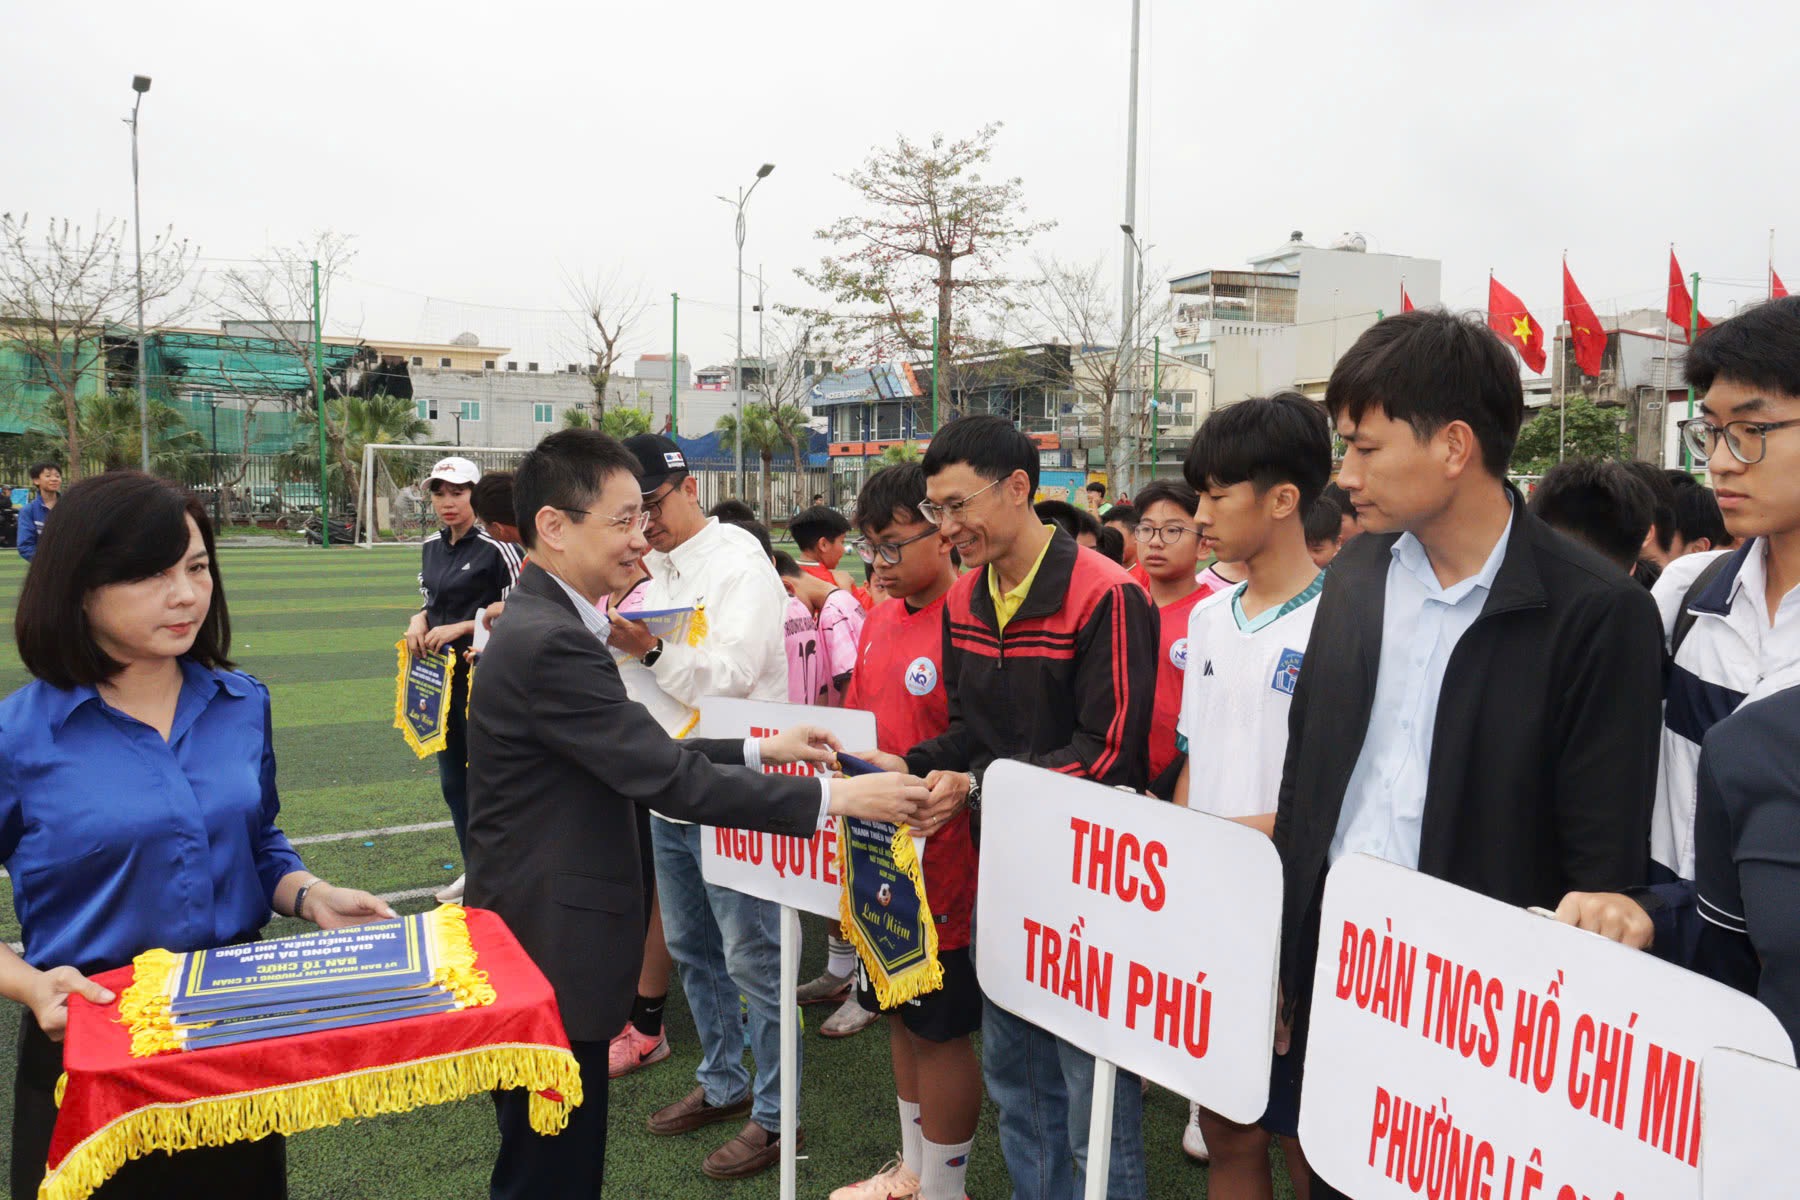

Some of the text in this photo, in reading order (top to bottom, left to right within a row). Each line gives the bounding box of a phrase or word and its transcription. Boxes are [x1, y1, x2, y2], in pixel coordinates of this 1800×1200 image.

[1071, 817, 1168, 912] THCS
[318, 936, 353, 946] THIẾU
[356, 932, 396, 941] THANH
[240, 943, 373, 962] GIẢI BÓNG ĐÁ NAM
[255, 944, 277, 952] NHI
[256, 962, 298, 973] CHỨC
[325, 957, 357, 967] BAN
[1023, 916, 1212, 1059] TRẦN PHÚ
[1335, 917, 1700, 1169] ĐOÀN TNCS HỒ CHÍ MI
[1368, 1085, 1495, 1200] PHƯỜNG
